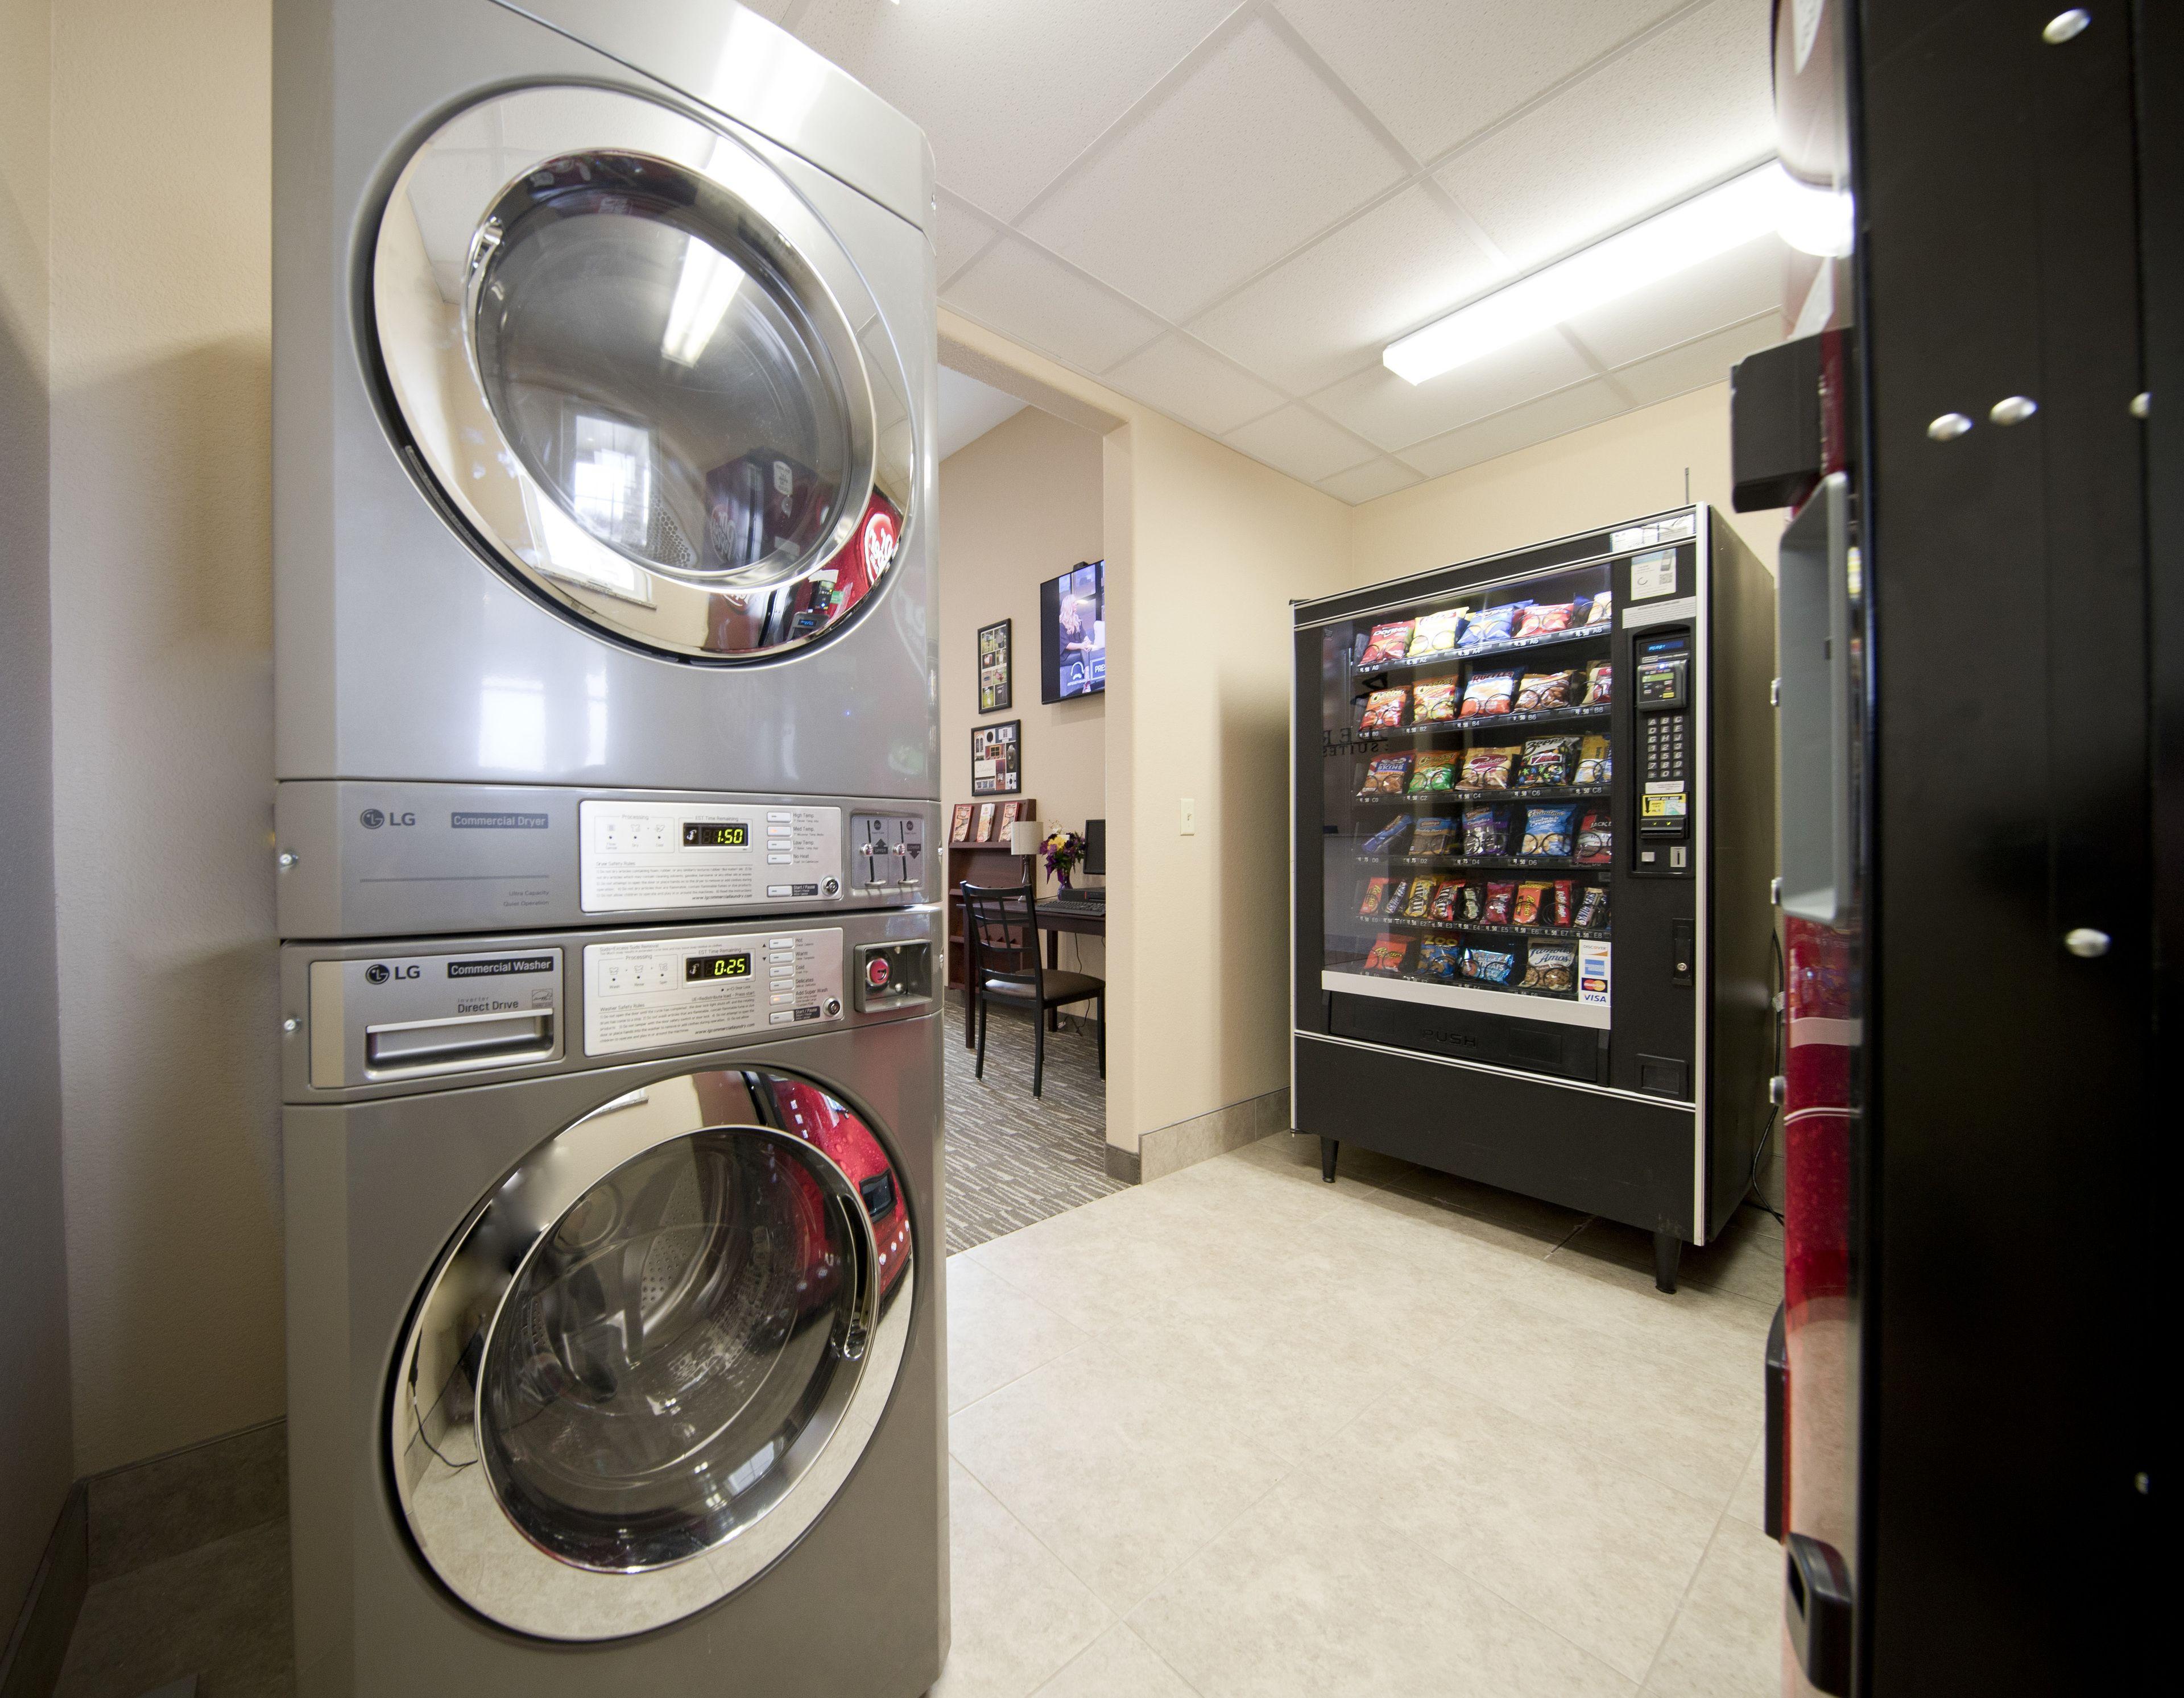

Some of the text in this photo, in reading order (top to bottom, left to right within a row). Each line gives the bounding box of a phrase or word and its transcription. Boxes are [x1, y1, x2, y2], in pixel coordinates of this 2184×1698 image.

[390, 813, 415, 826] LG
[454, 815, 545, 828] Commercial Dryer
[718, 829, 742, 844] 1.50
[1528, 943, 1572, 957] Famous
[1536, 954, 1571, 965] Amos
[395, 966, 420, 979] LG
[451, 959, 551, 975] Commercial Washer
[715, 959, 744, 975] 0.25
[1585, 994, 1606, 1003] VISA
[458, 1001, 518, 1013] Direct Drive
[1422, 1030, 1477, 1047] PUSH
